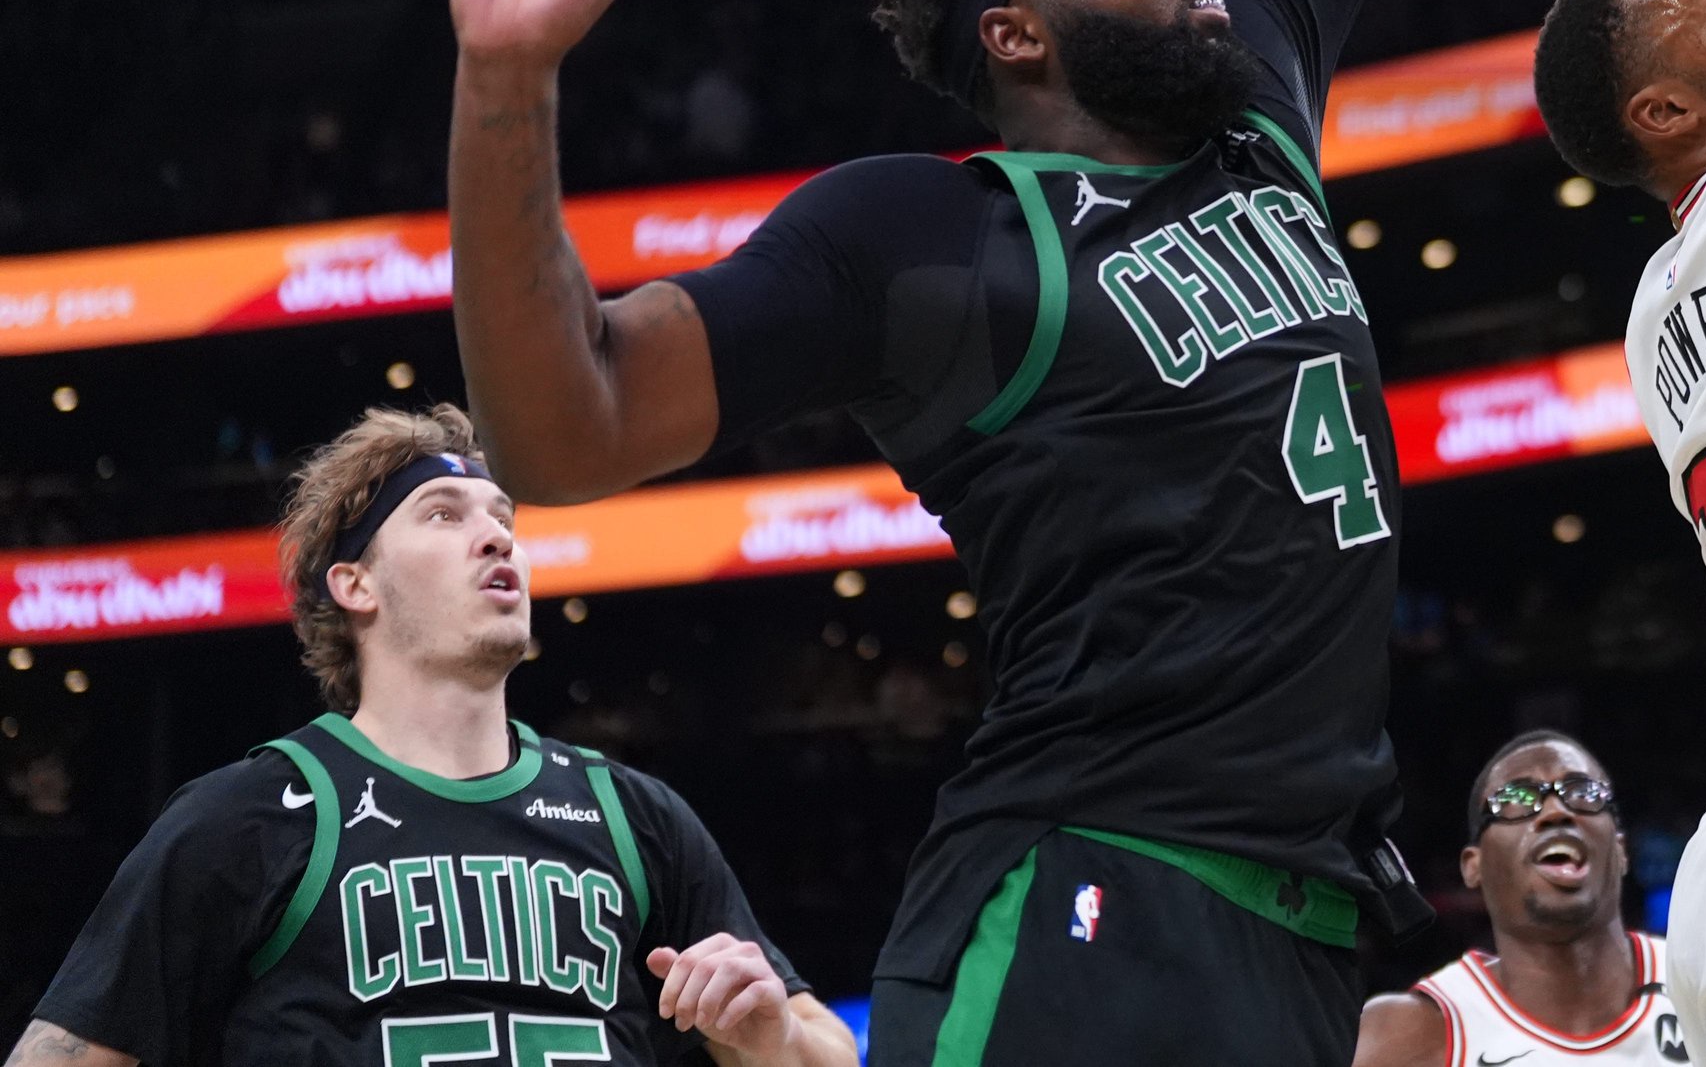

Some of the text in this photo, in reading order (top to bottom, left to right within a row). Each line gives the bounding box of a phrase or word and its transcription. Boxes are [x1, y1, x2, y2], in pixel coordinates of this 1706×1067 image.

[1281, 352, 1392, 550] 4
[525, 798, 601, 823] Amica
[340, 855, 623, 1012] CELTICS
